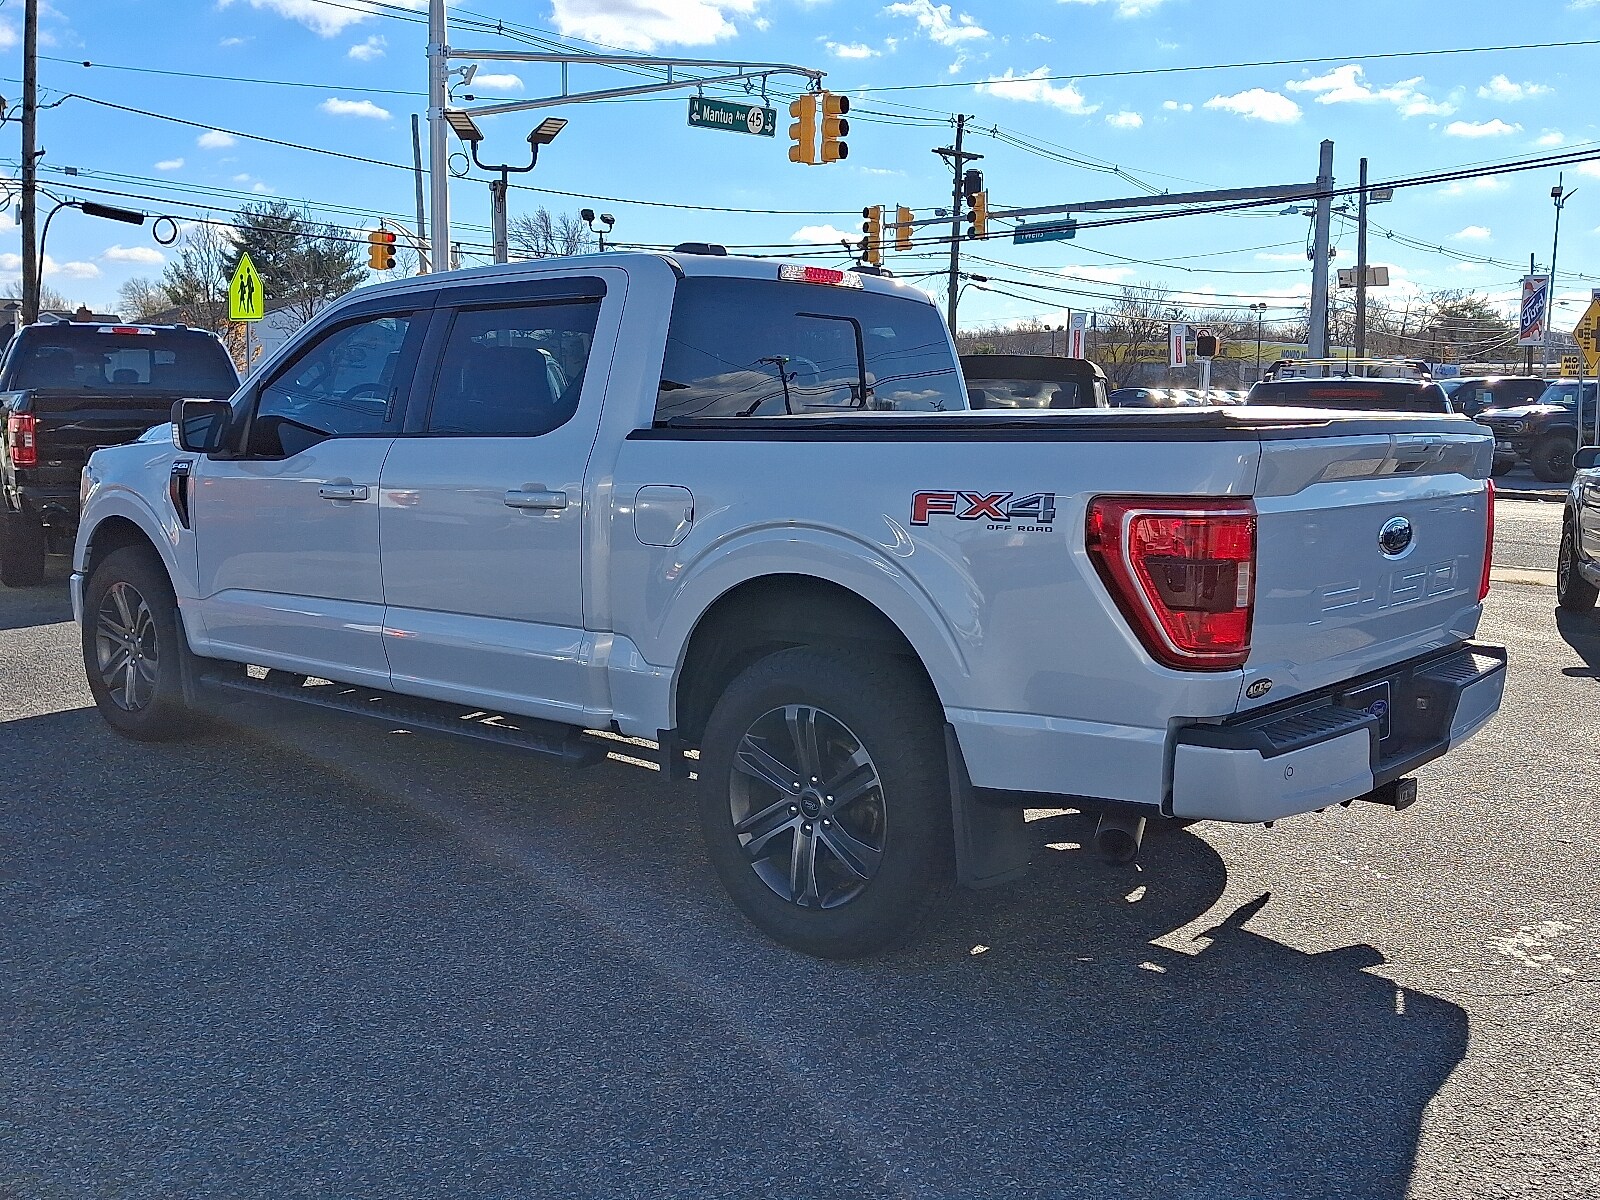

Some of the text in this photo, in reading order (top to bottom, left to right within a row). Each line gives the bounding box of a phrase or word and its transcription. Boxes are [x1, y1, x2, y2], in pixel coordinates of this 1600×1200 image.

[693, 101, 699, 111] N
[702, 105, 746, 124] Mantua Ave
[748, 112, 762, 127] 45
[767, 112, 773, 122] S
[1522, 293, 1544, 326] Ford
[910, 489, 1056, 526] FX4
[1018, 525, 1053, 533] ROAD
